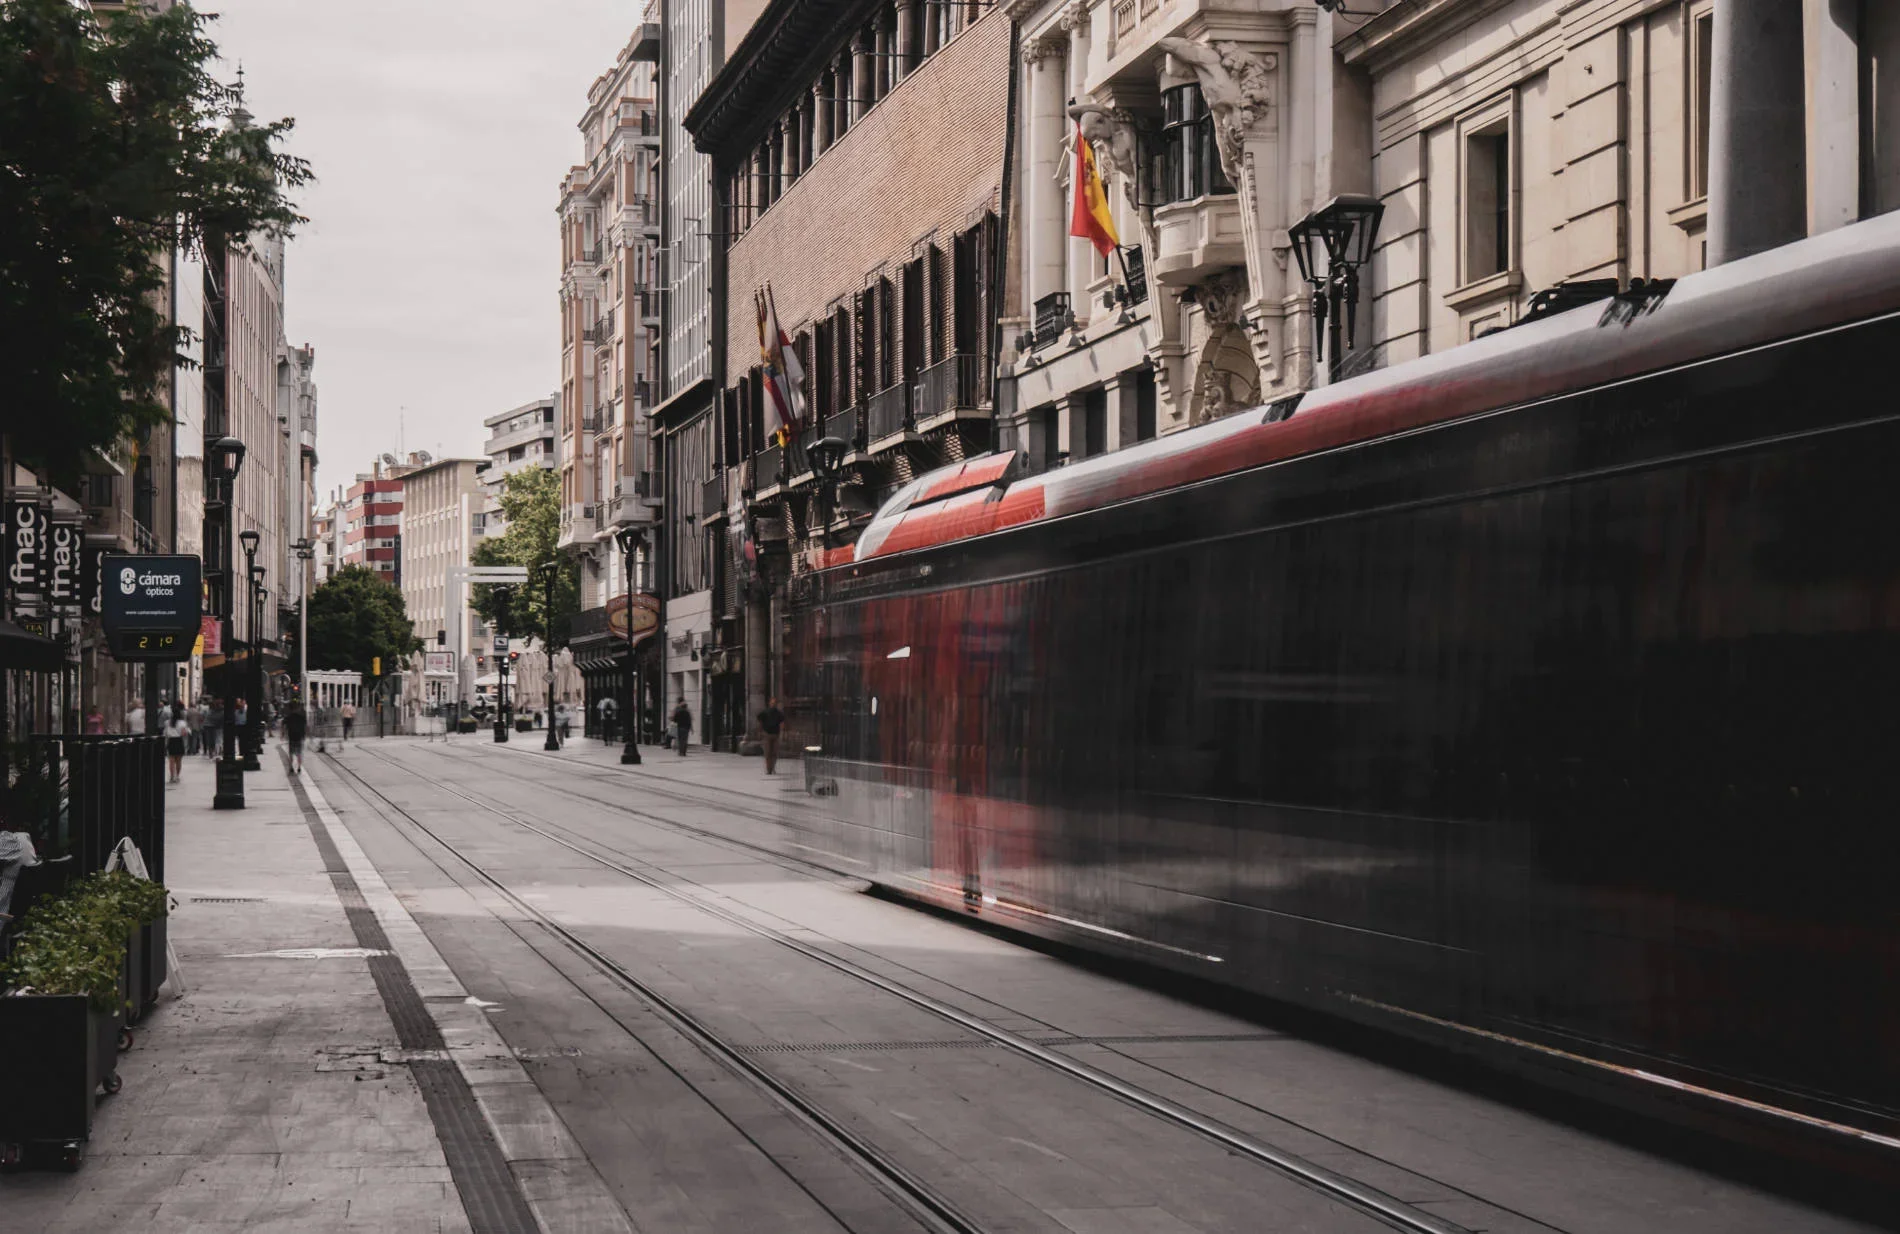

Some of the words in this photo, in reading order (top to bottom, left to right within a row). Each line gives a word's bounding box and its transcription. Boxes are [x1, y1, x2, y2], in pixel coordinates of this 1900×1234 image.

[9, 506, 35, 584] fnac
[51, 527, 71, 598] fnac
[138, 570, 181, 586] cámara
